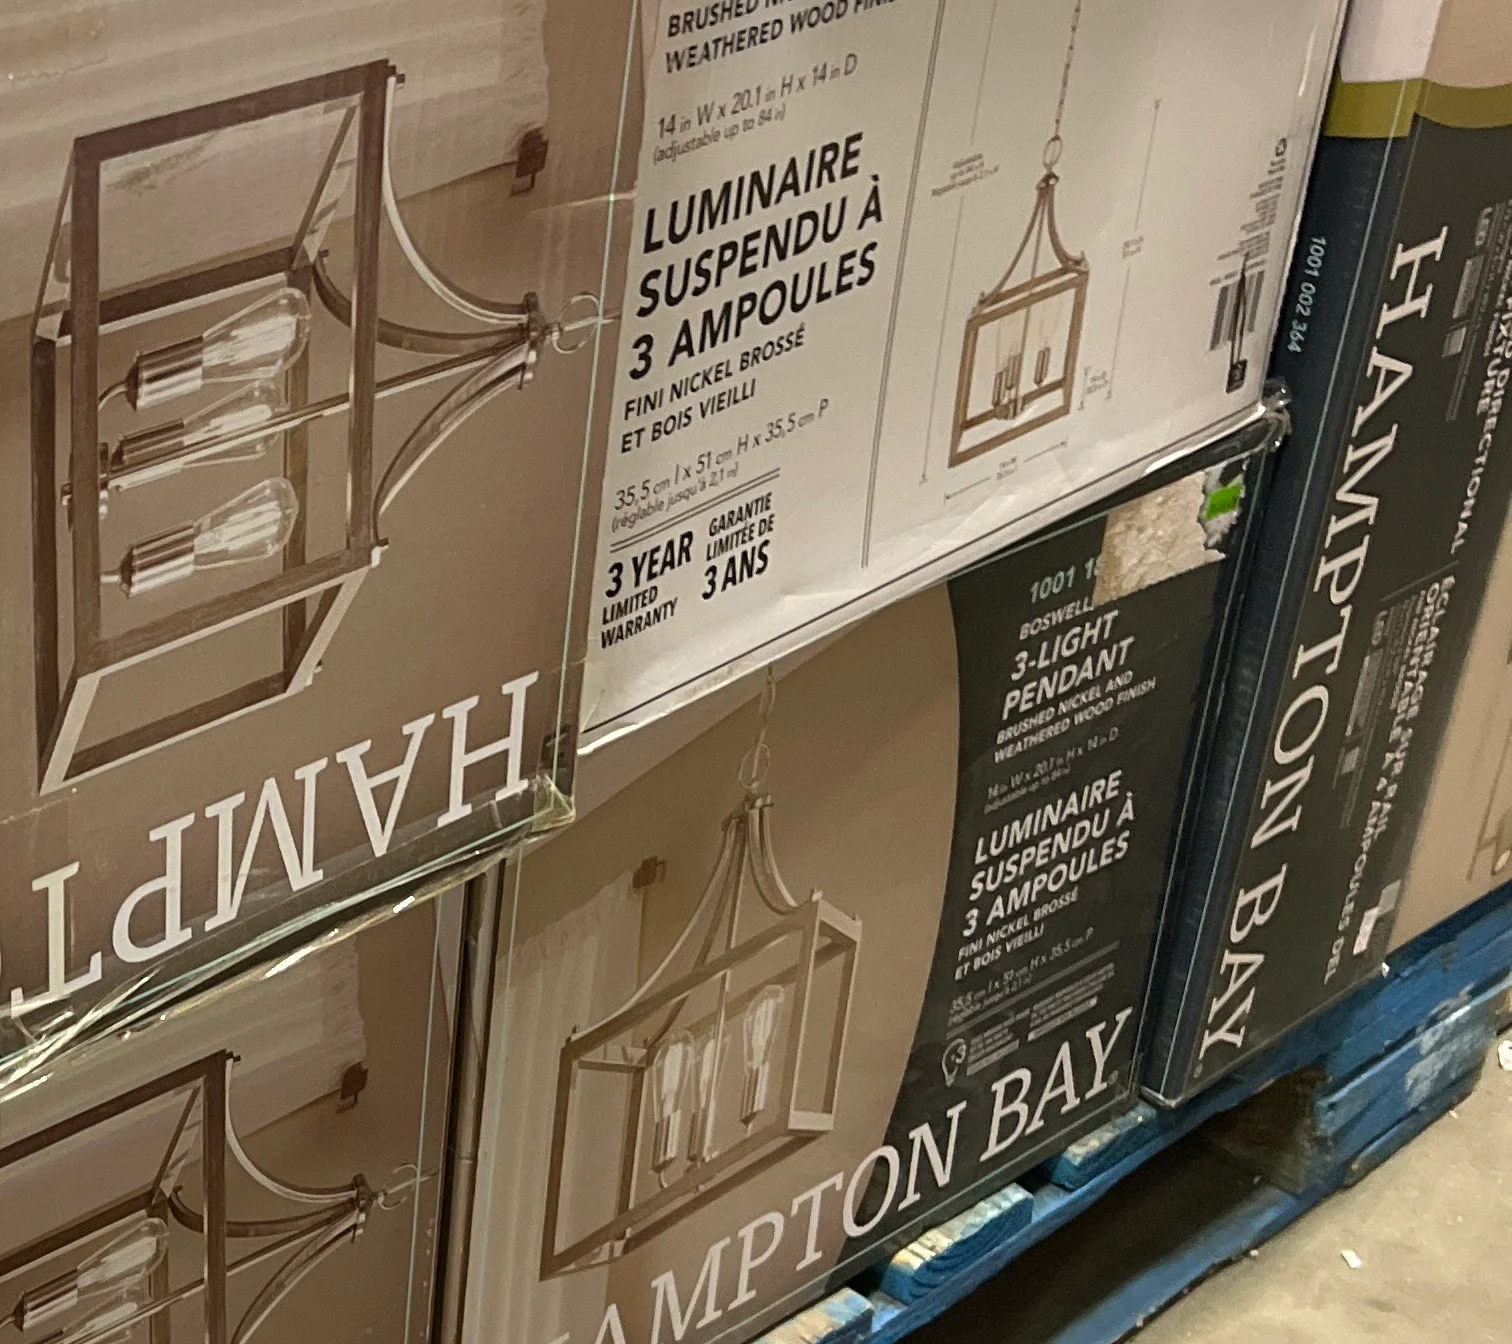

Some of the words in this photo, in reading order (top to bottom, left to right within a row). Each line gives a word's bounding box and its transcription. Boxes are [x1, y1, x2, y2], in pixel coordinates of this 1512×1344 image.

[665, 18, 783, 74] WEATHERED
[642, 132, 864, 254] LUMINAIRE
[636, 197, 848, 318] SUSPENDU
[858, 175, 884, 233] À
[1305, 236, 1327, 278] 1001
[628, 334, 653, 380] 3
[668, 241, 877, 367] AMPOULES
[1287, 318, 1310, 353] 364
[1296, 282, 1317, 317] 002
[707, 491, 773, 537] GARANTIE
[1248, 224, 1449, 853] HAMPTON
[606, 562, 625, 598] 3
[629, 530, 694, 590] YEAR
[701, 568, 719, 601] 3
[720, 538, 770, 594] ANS
[599, 598, 678, 650] WARRANTY
[602, 585, 659, 627] LIMITED
[1001, 636, 1135, 721] PENDANT
[1010, 609, 1119, 684] 3-LIGHT
[968, 811, 1107, 902] SUSPENDU
[1116, 791, 1135, 826] À
[974, 769, 1123, 866] LUMINAIRE
[962, 907, 979, 938] 3
[986, 831, 1129, 927] AMPOULES
[1197, 863, 1288, 1063] BAY
[980, 1007, 1134, 1163] BAY
